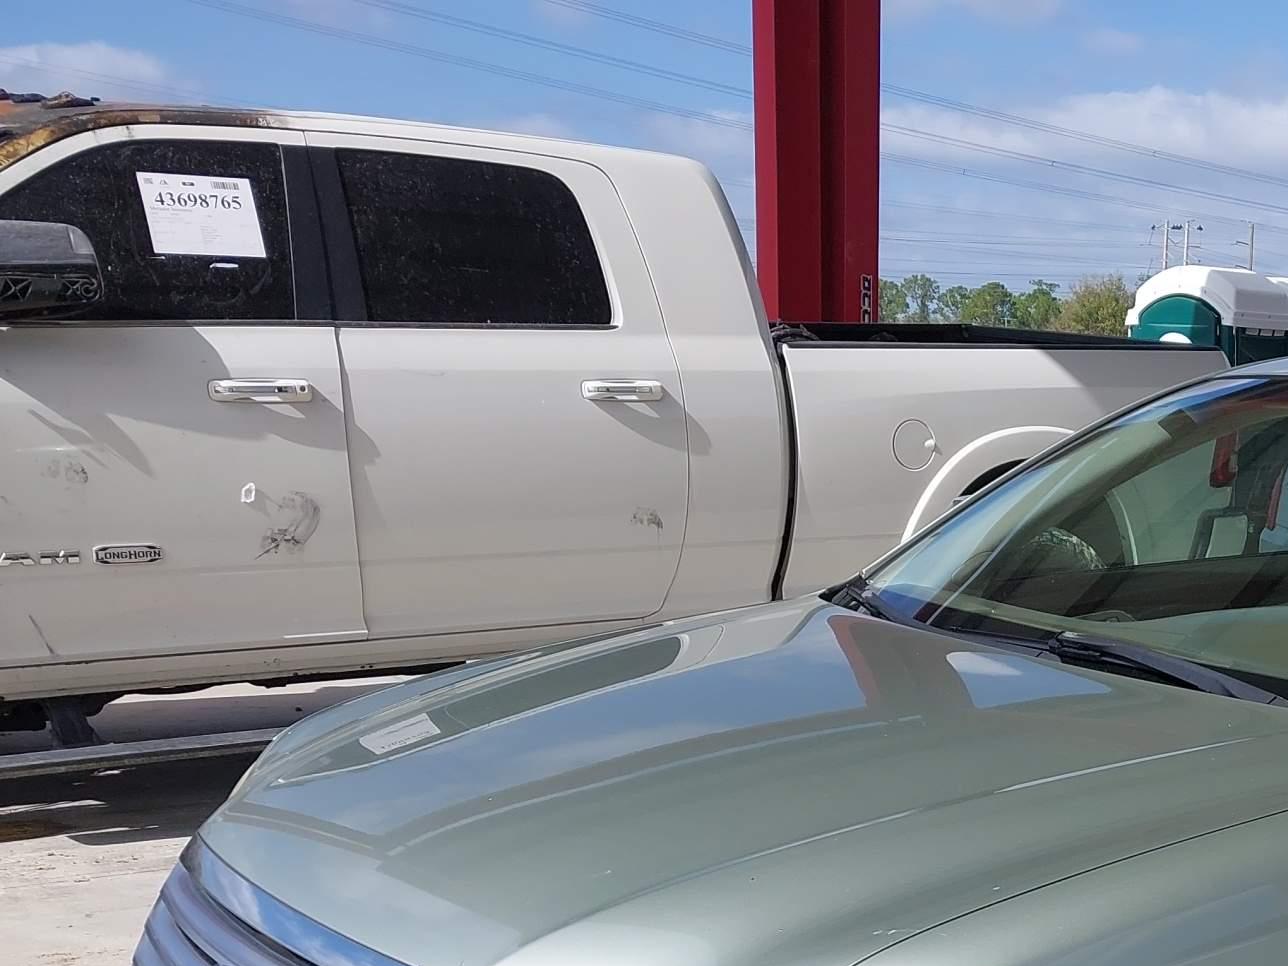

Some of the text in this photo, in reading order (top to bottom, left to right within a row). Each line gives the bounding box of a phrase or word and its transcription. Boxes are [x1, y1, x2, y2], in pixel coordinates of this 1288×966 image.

[154, 191, 242, 210] 43698765
[0, 549, 81, 567] AM
[95, 549, 162, 563] LONGHORN
